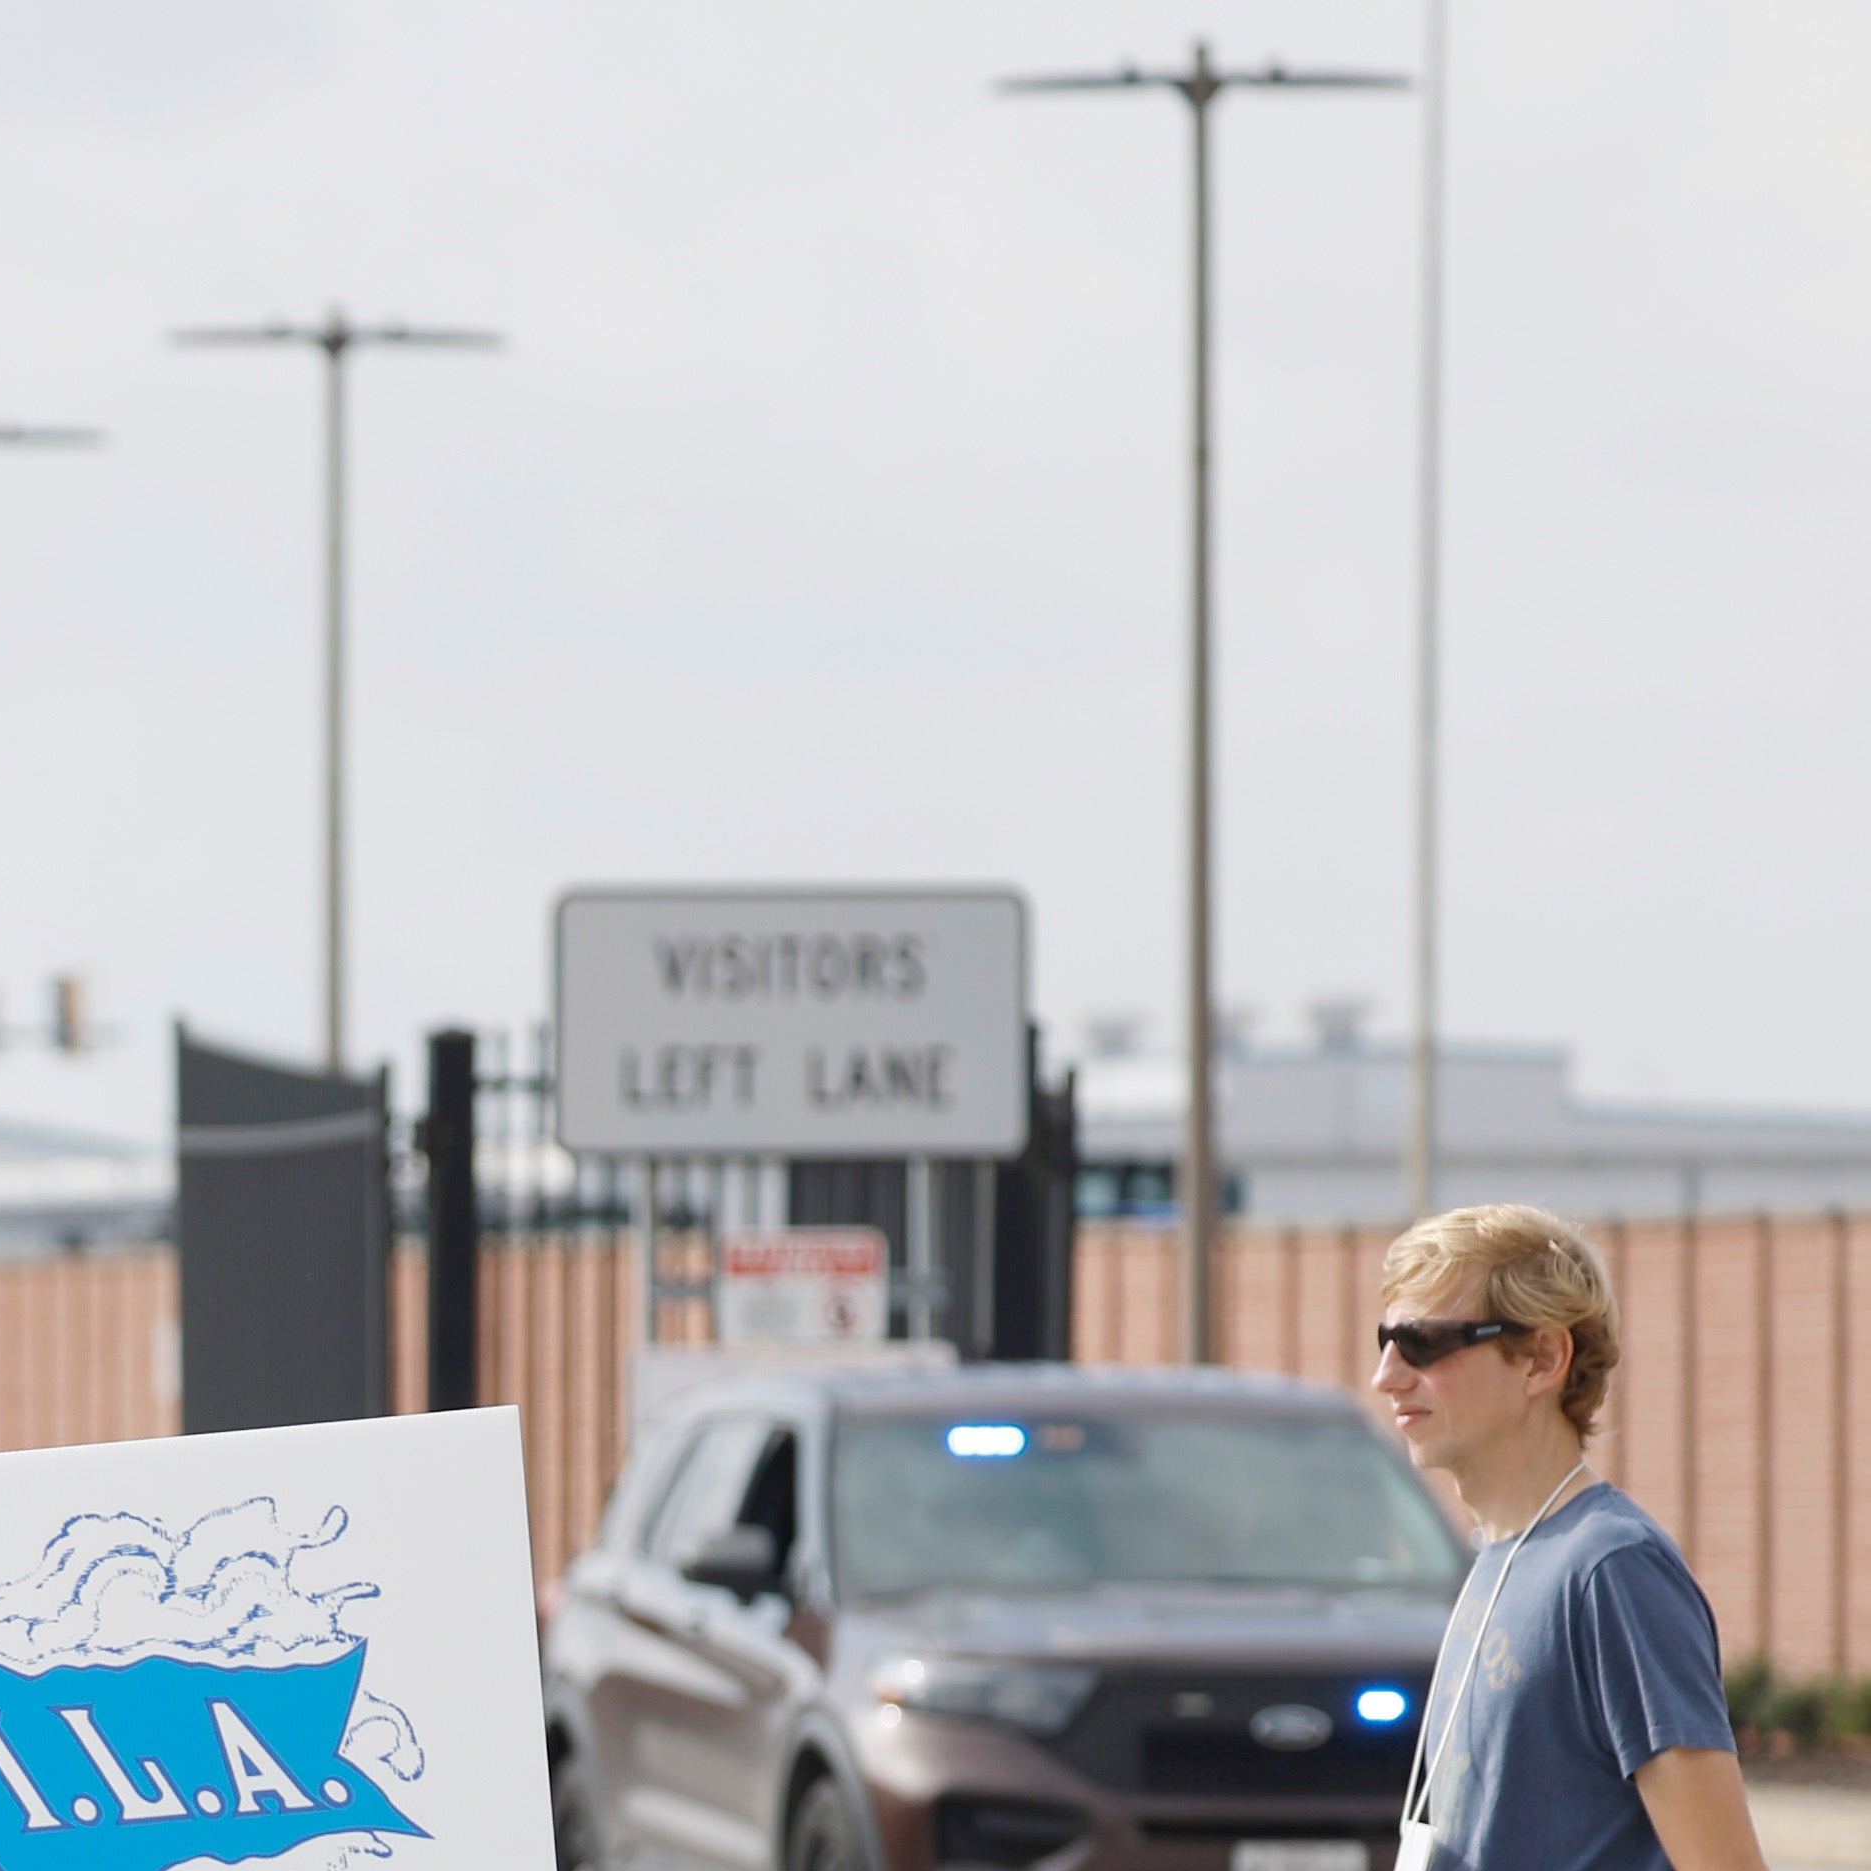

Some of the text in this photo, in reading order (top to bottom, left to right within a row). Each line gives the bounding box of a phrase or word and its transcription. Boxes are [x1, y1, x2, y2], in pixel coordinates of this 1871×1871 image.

[656, 936, 926, 997] VISITORS
[620, 1044, 958, 1111] LEFT LANE
